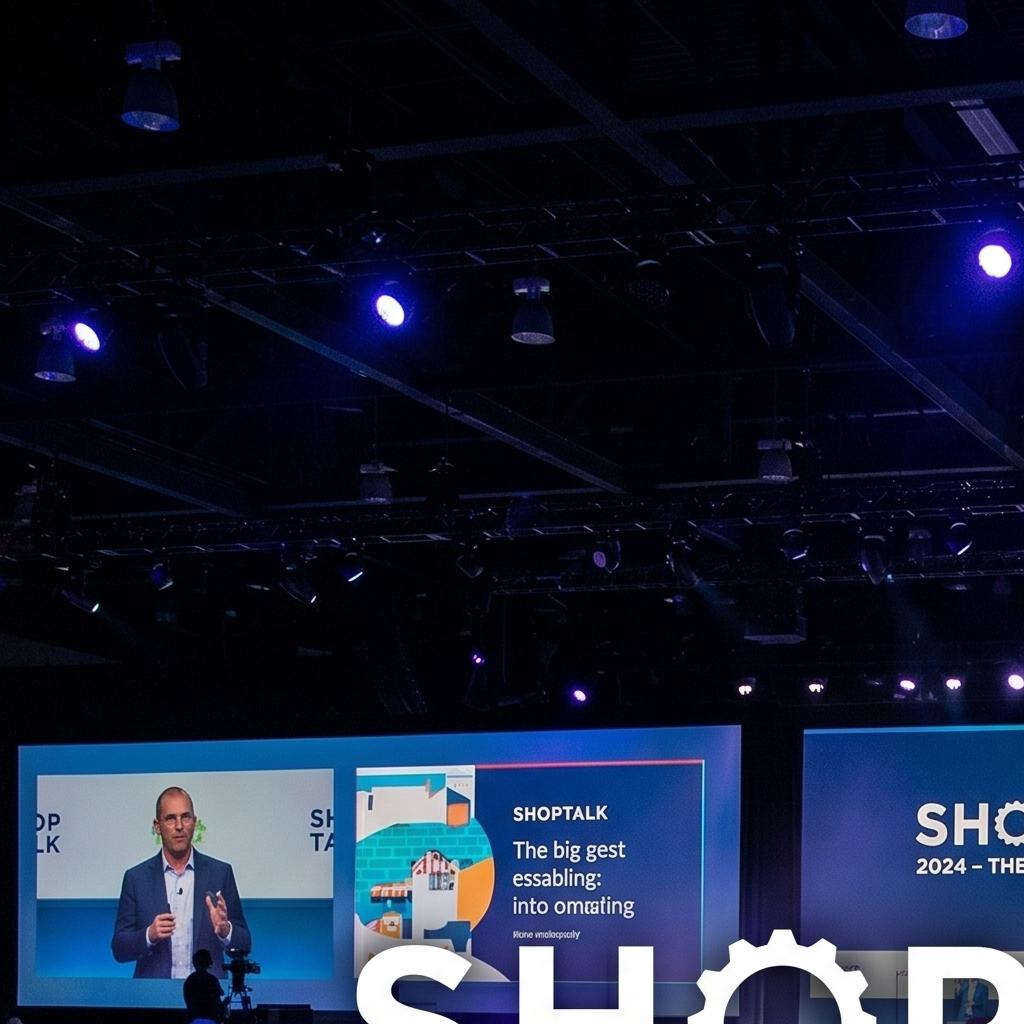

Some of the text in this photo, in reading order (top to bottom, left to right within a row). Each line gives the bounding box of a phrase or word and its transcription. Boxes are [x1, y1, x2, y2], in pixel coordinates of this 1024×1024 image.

[512, 805, 609, 822] SHOPTALK
[512, 840, 627, 863] The big gest
[916, 857, 967, 875] 2024
[512, 868, 602, 891] essabling:
[513, 896, 549, 915] into
